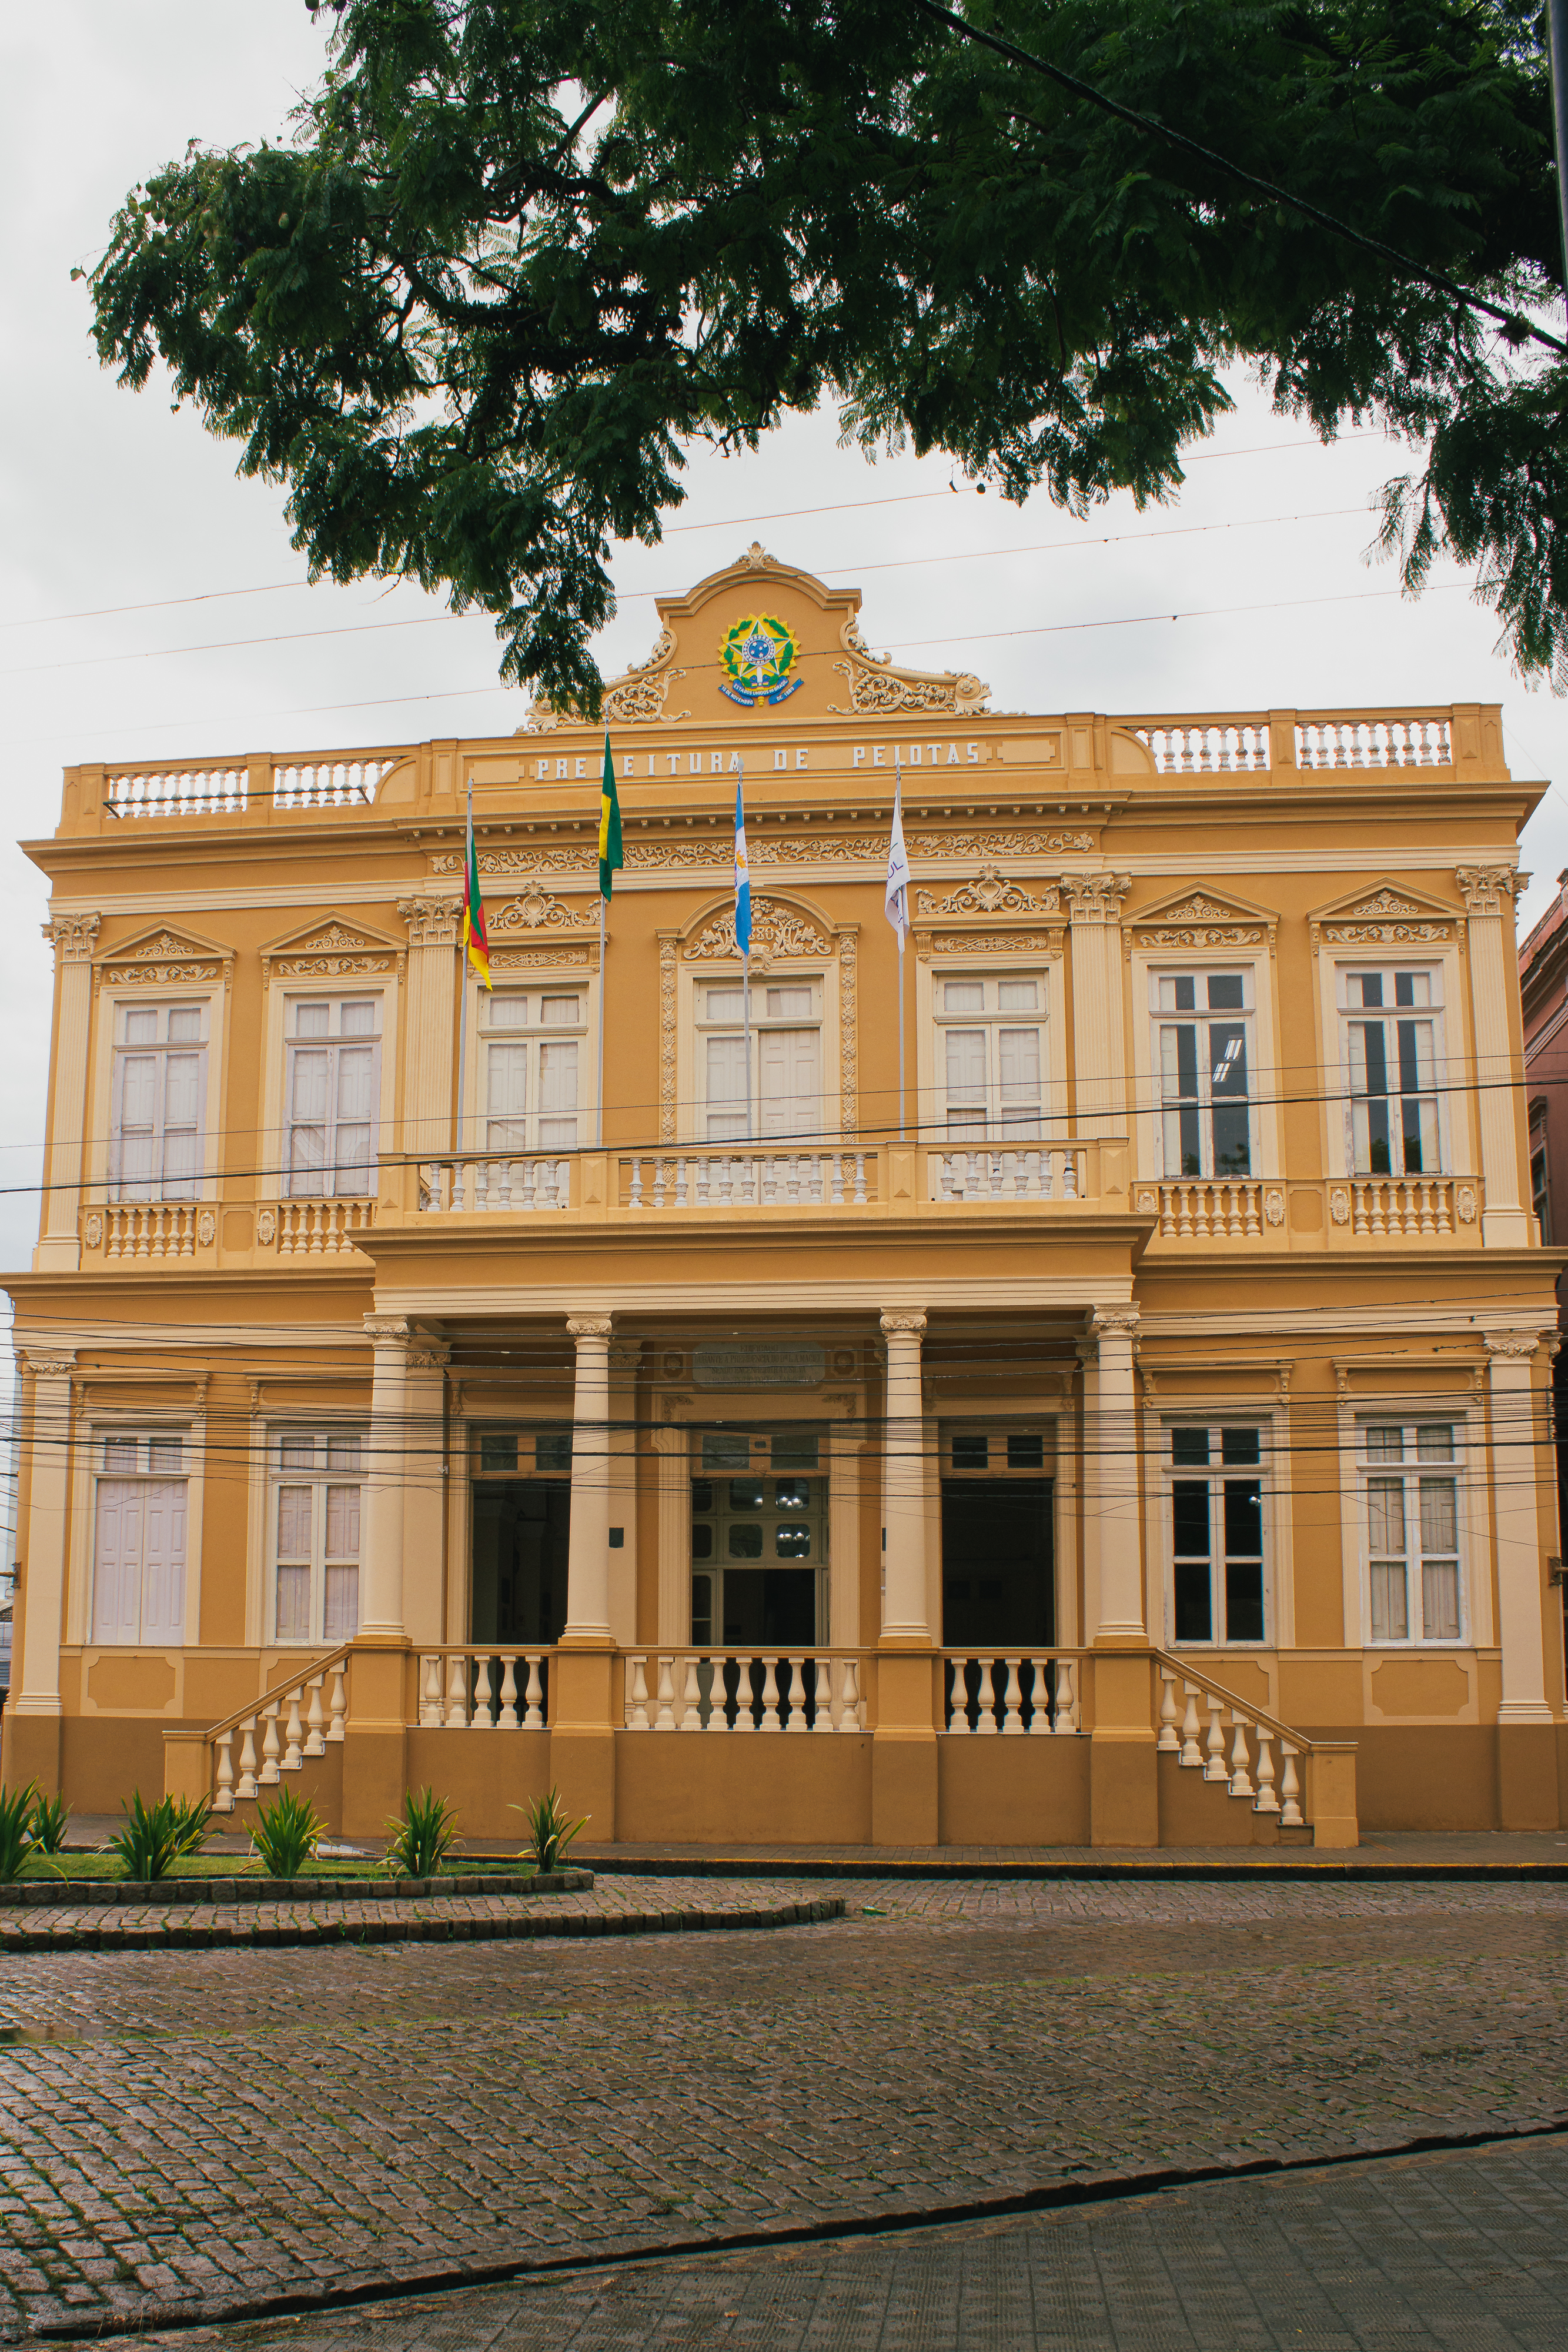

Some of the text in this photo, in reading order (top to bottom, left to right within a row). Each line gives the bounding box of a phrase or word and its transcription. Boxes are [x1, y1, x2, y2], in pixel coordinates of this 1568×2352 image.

[734, 684, 752, 696] ESTADOS
[774, 680, 788, 691] BRASIL
[731, 694, 753, 705] NOVEMBRO
[773, 749, 808, 770] DE
[853, 743, 978, 768] PELOTAS
